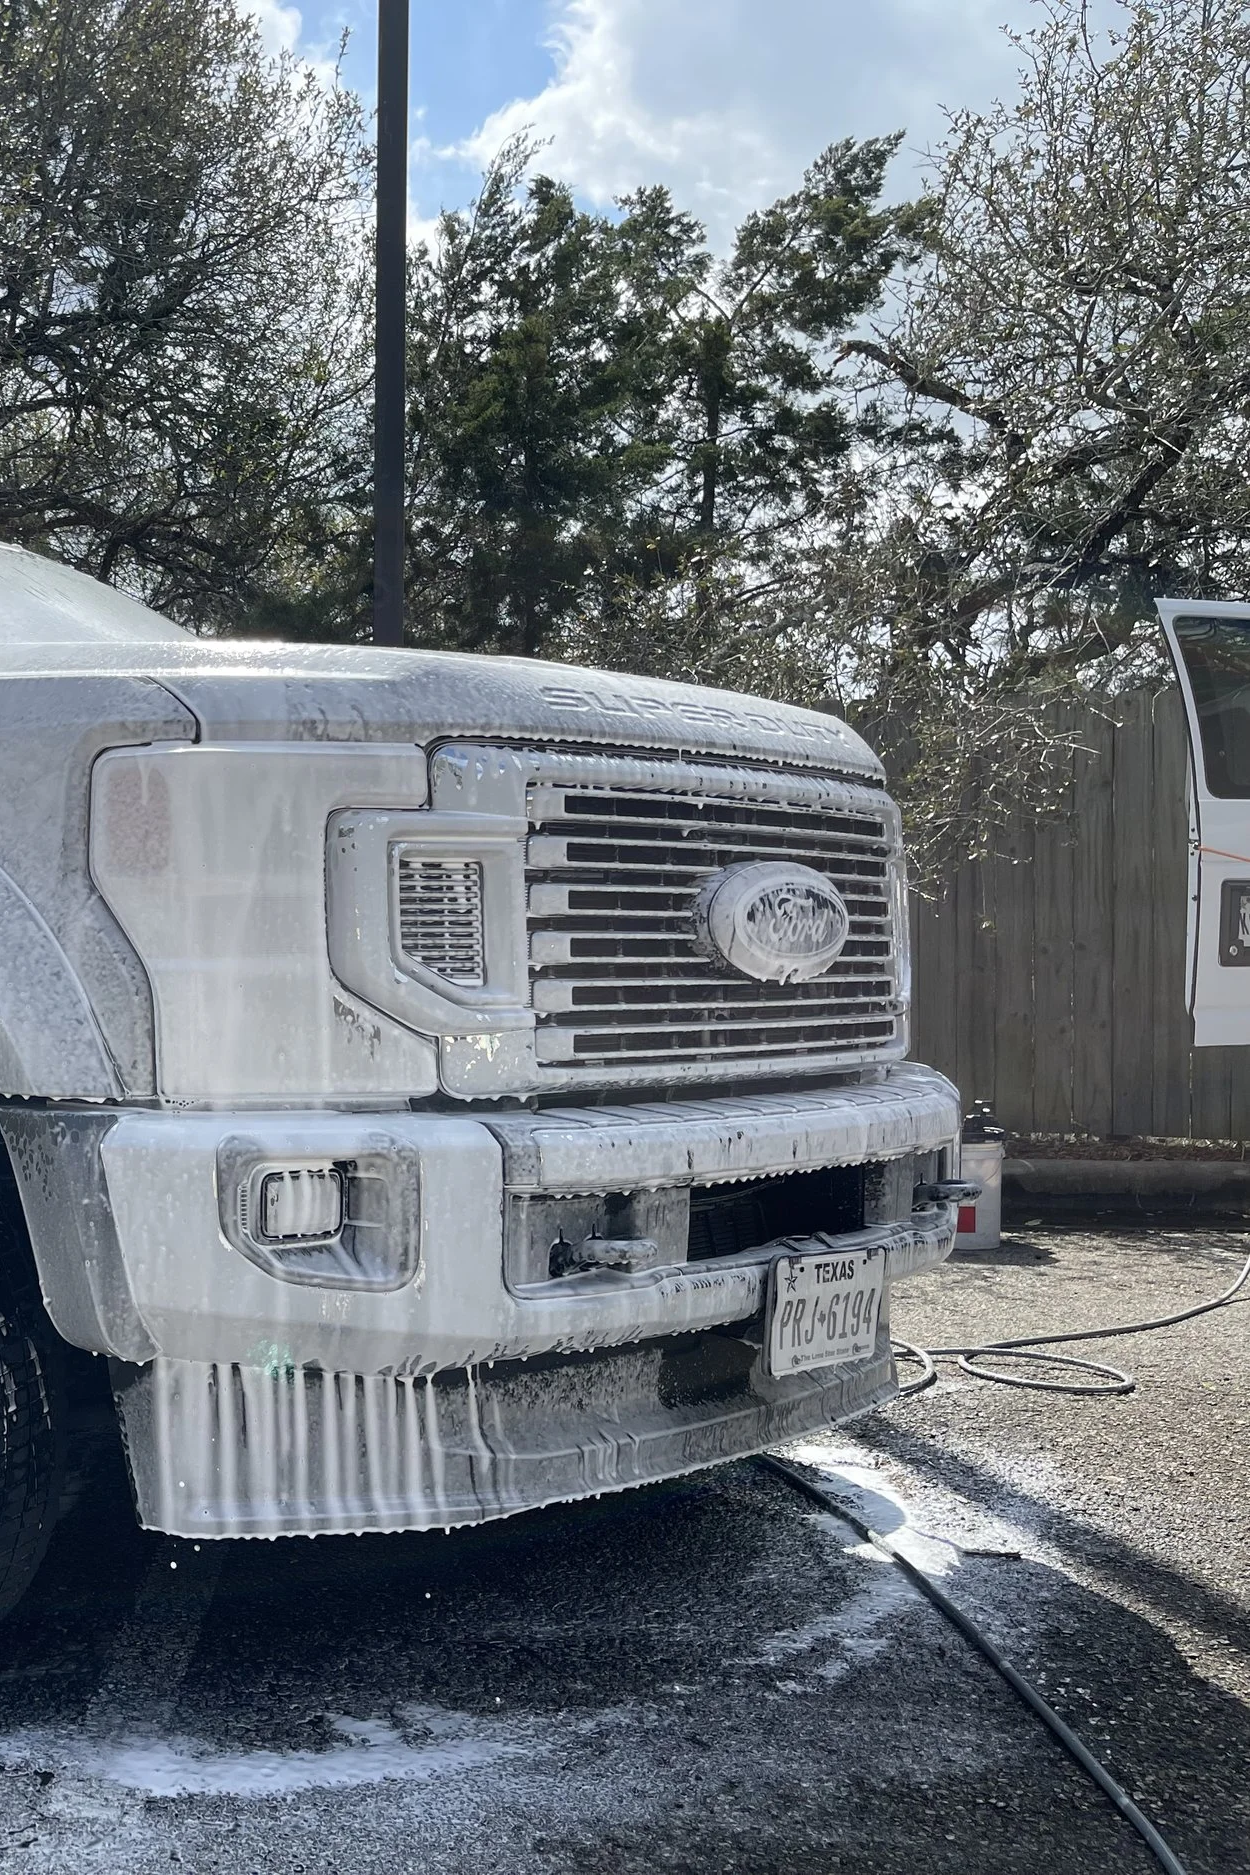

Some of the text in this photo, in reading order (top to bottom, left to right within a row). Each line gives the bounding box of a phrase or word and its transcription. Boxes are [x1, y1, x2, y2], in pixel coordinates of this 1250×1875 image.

[540, 685, 851, 748] SUPER DUTY
[769, 894, 828, 944] Ford
[814, 1259, 855, 1284] TEXAS
[779, 1288, 876, 1350] PRJ 6194
